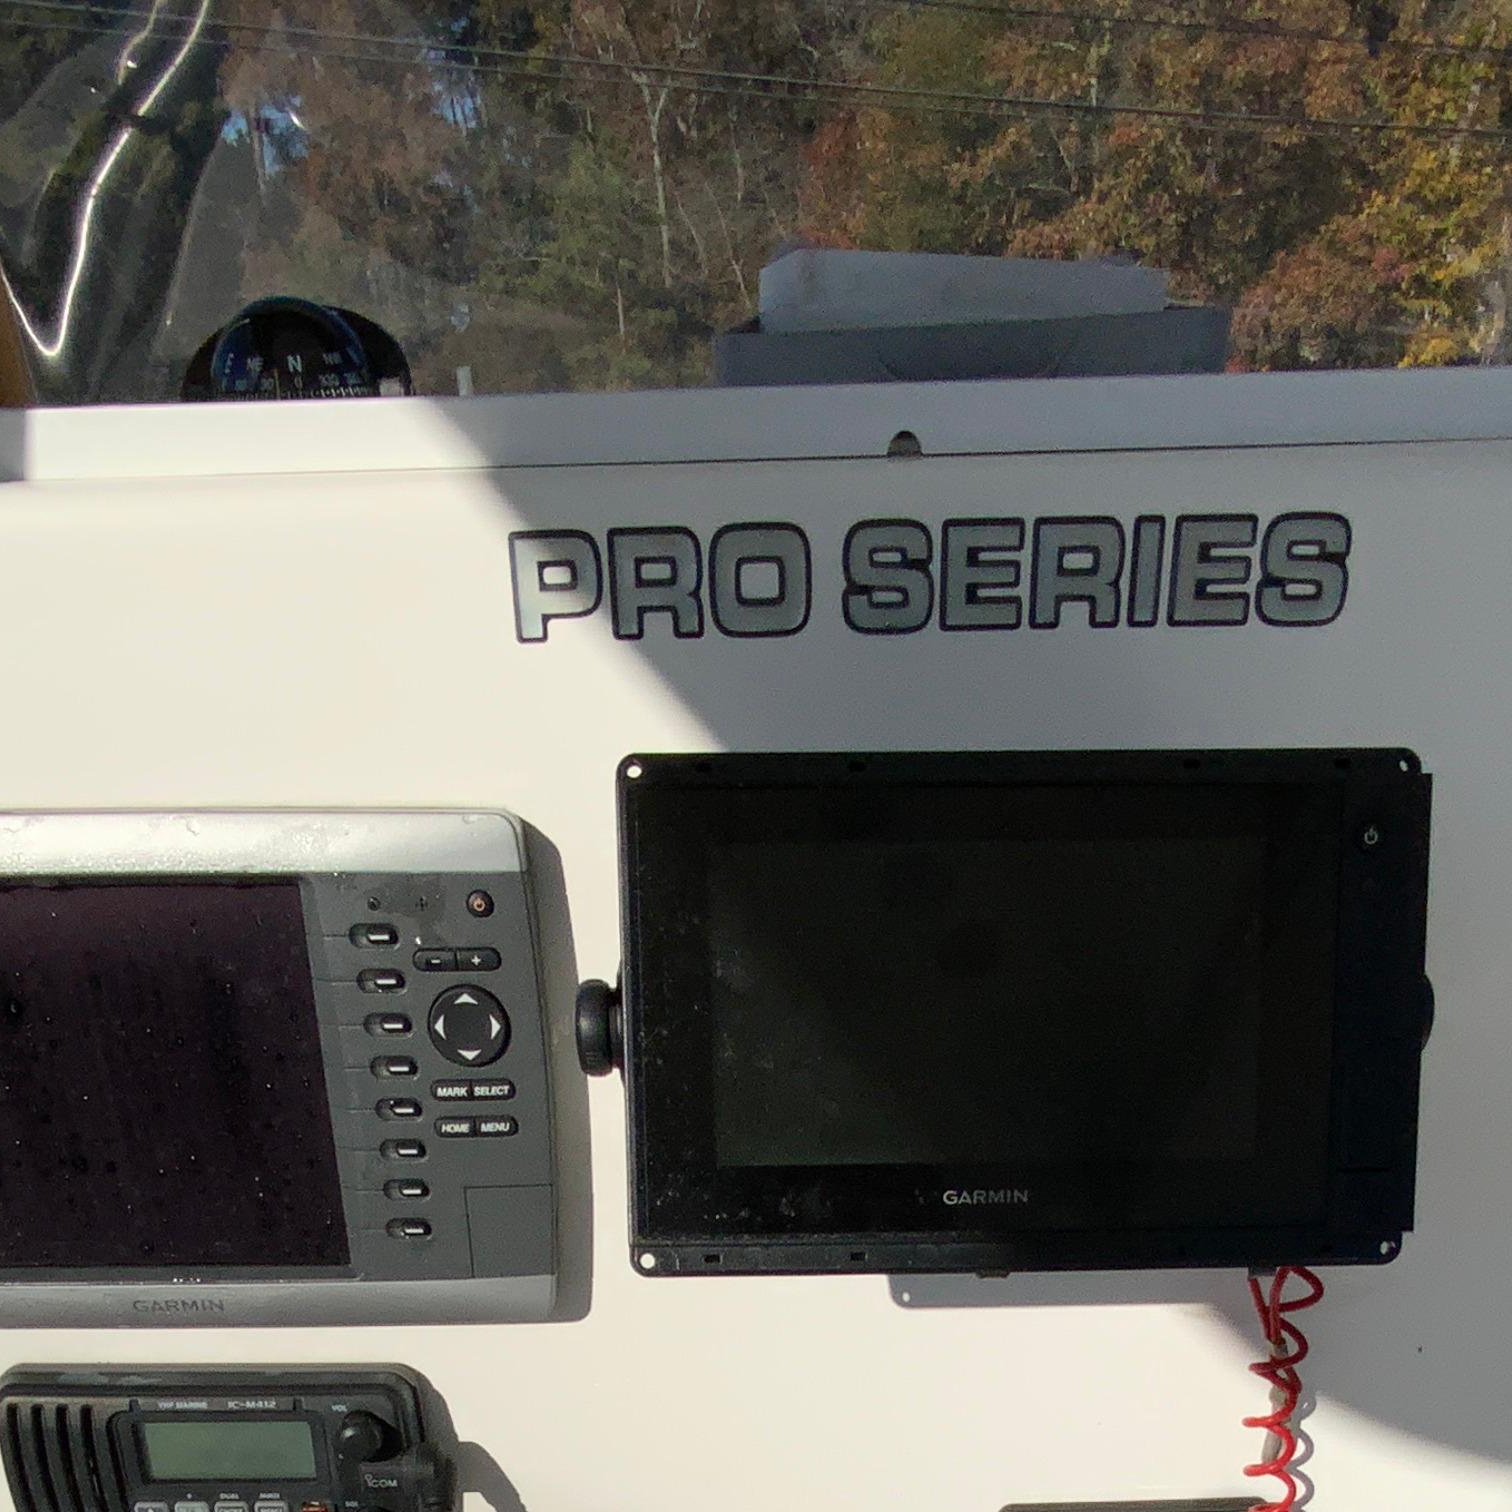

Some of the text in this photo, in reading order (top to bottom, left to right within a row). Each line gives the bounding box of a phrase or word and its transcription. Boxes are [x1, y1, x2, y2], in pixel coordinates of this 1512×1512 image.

[287, 354, 303, 373] N
[508, 511, 1354, 643] PRO SERIES
[437, 1086, 468, 1097] MARK
[474, 1085, 510, 1096] SELECT
[441, 1123, 470, 1133] HOME
[480, 1122, 510, 1132] MENU
[942, 1188, 1030, 1205] GARMIN
[132, 1299, 226, 1312] GARMIN
